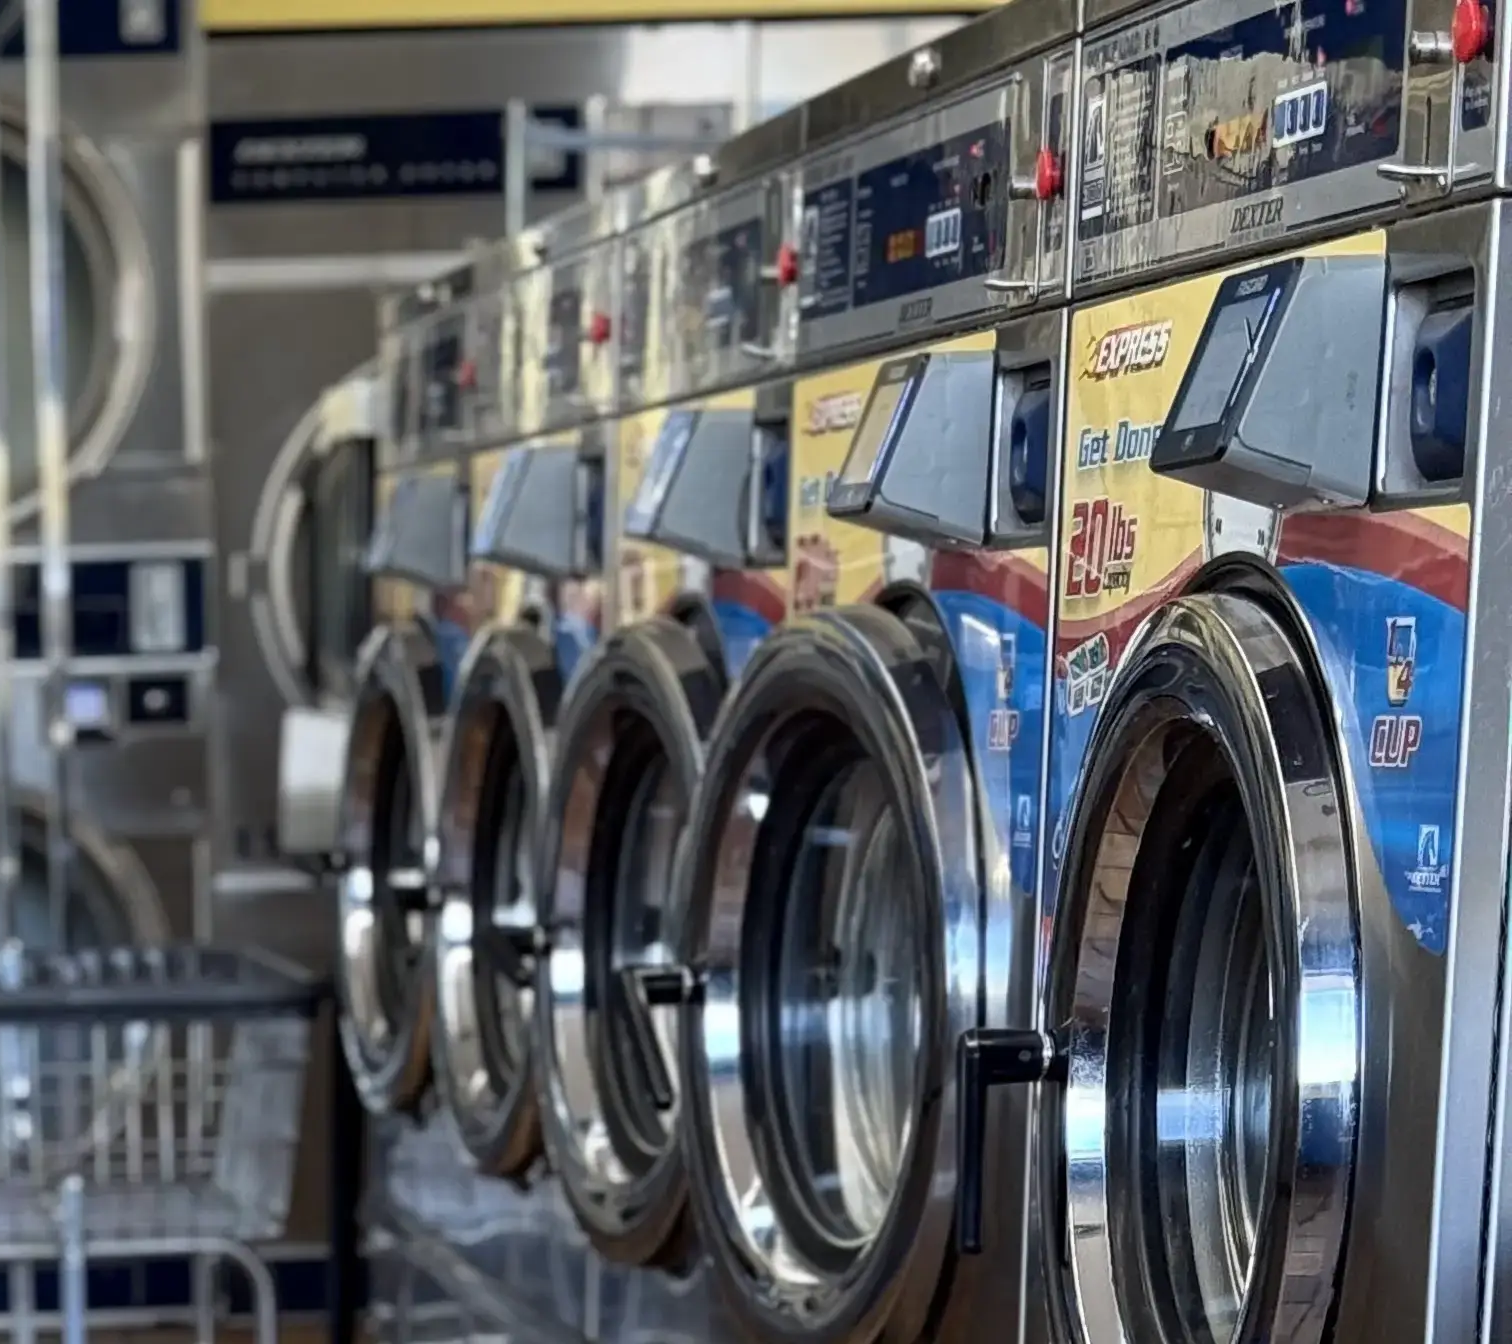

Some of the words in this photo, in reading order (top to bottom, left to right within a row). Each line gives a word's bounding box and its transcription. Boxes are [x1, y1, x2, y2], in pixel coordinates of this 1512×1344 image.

[1230, 196, 1284, 233] DEXTER
[1095, 320, 1173, 374] EXPRESS
[1078, 427, 1109, 468] Get
[1065, 498, 1109, 596] 20
[1107, 504, 1138, 562] lbs
[1369, 716, 1422, 767] CUP
